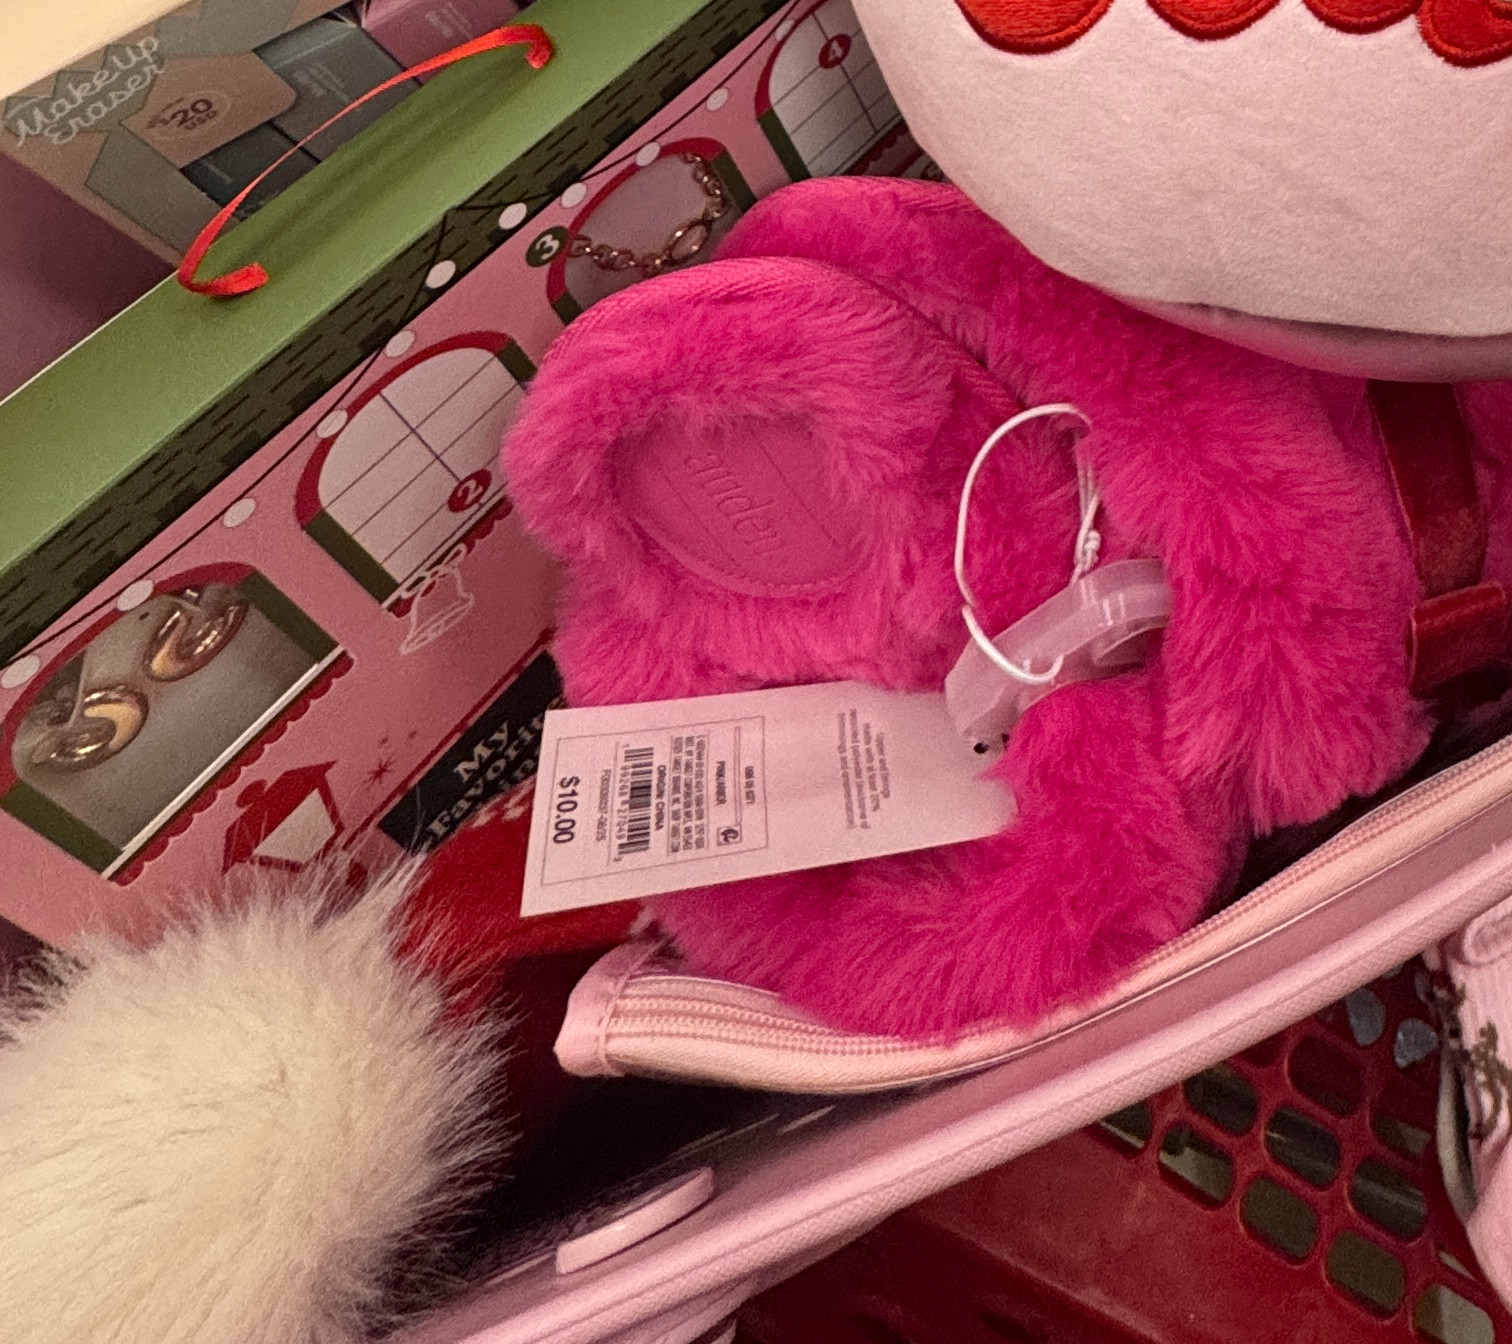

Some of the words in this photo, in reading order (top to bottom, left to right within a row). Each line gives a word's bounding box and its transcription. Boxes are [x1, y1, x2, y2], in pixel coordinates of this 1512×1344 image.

[827, 40, 844, 61] 4
[44, 64, 165, 146] Eraser
[536, 233, 560, 261] 3
[457, 478, 484, 505] 2
[453, 720, 509, 782] My
[553, 776, 580, 844] $10.00
[654, 801, 665, 831] CHINA
